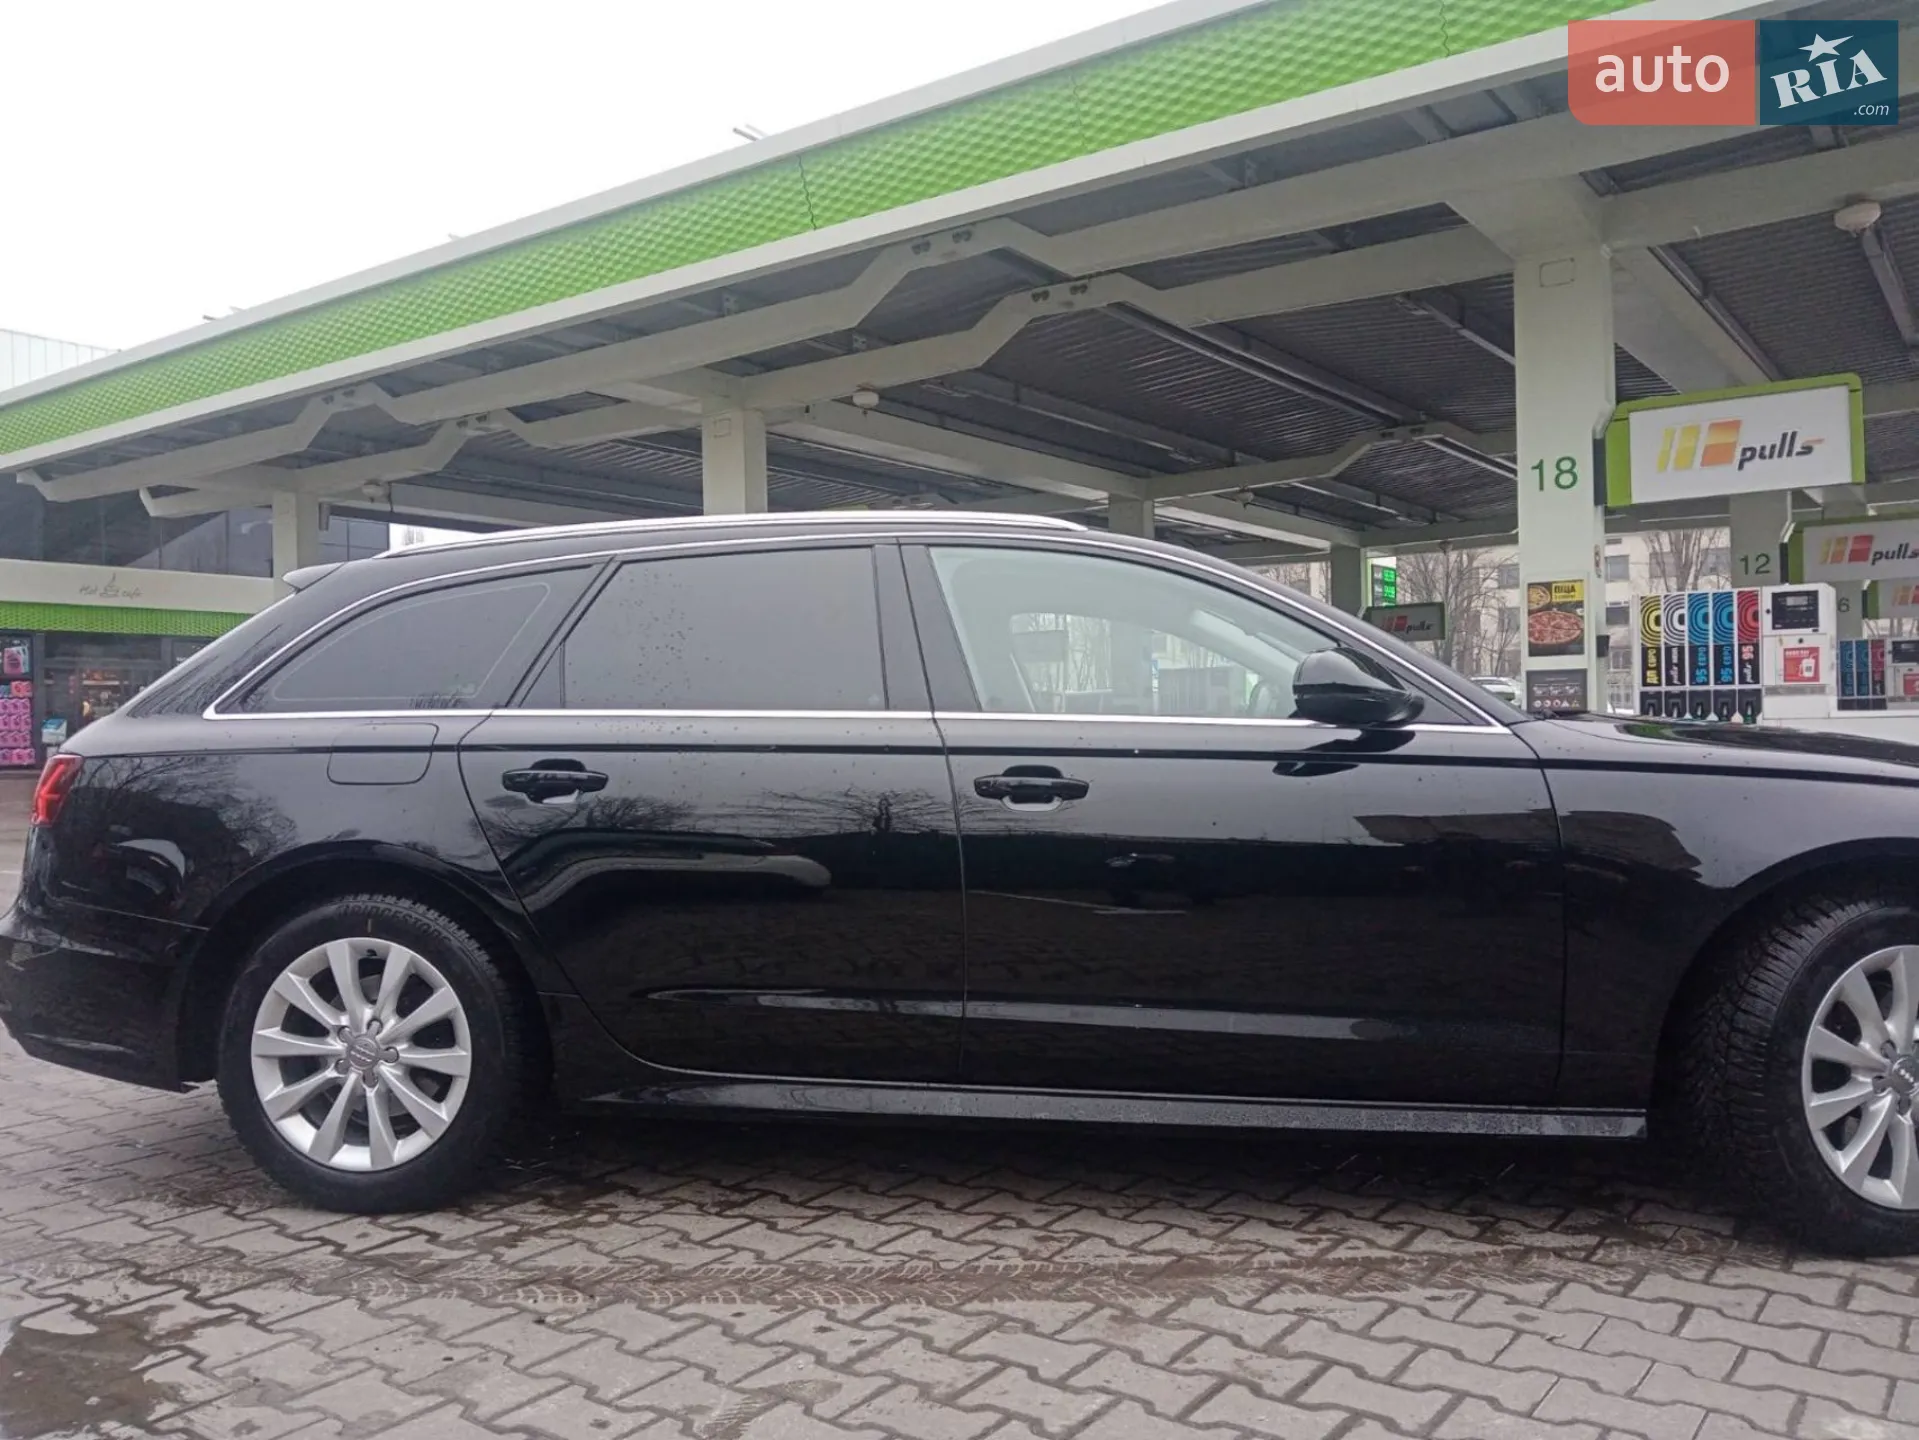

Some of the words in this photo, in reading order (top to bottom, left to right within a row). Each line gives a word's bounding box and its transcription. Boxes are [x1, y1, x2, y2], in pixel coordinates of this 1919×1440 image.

[1737, 430, 1824, 471] pulls
[1531, 455, 1578, 491] 18
[1871, 542, 1919, 566] pulls
[1740, 553, 1771, 575] 12
[1837, 598, 1850, 613] 6
[1741, 645, 1754, 660] 95
[1696, 668, 1707, 682] 95
[1721, 667, 1733, 682] 95
